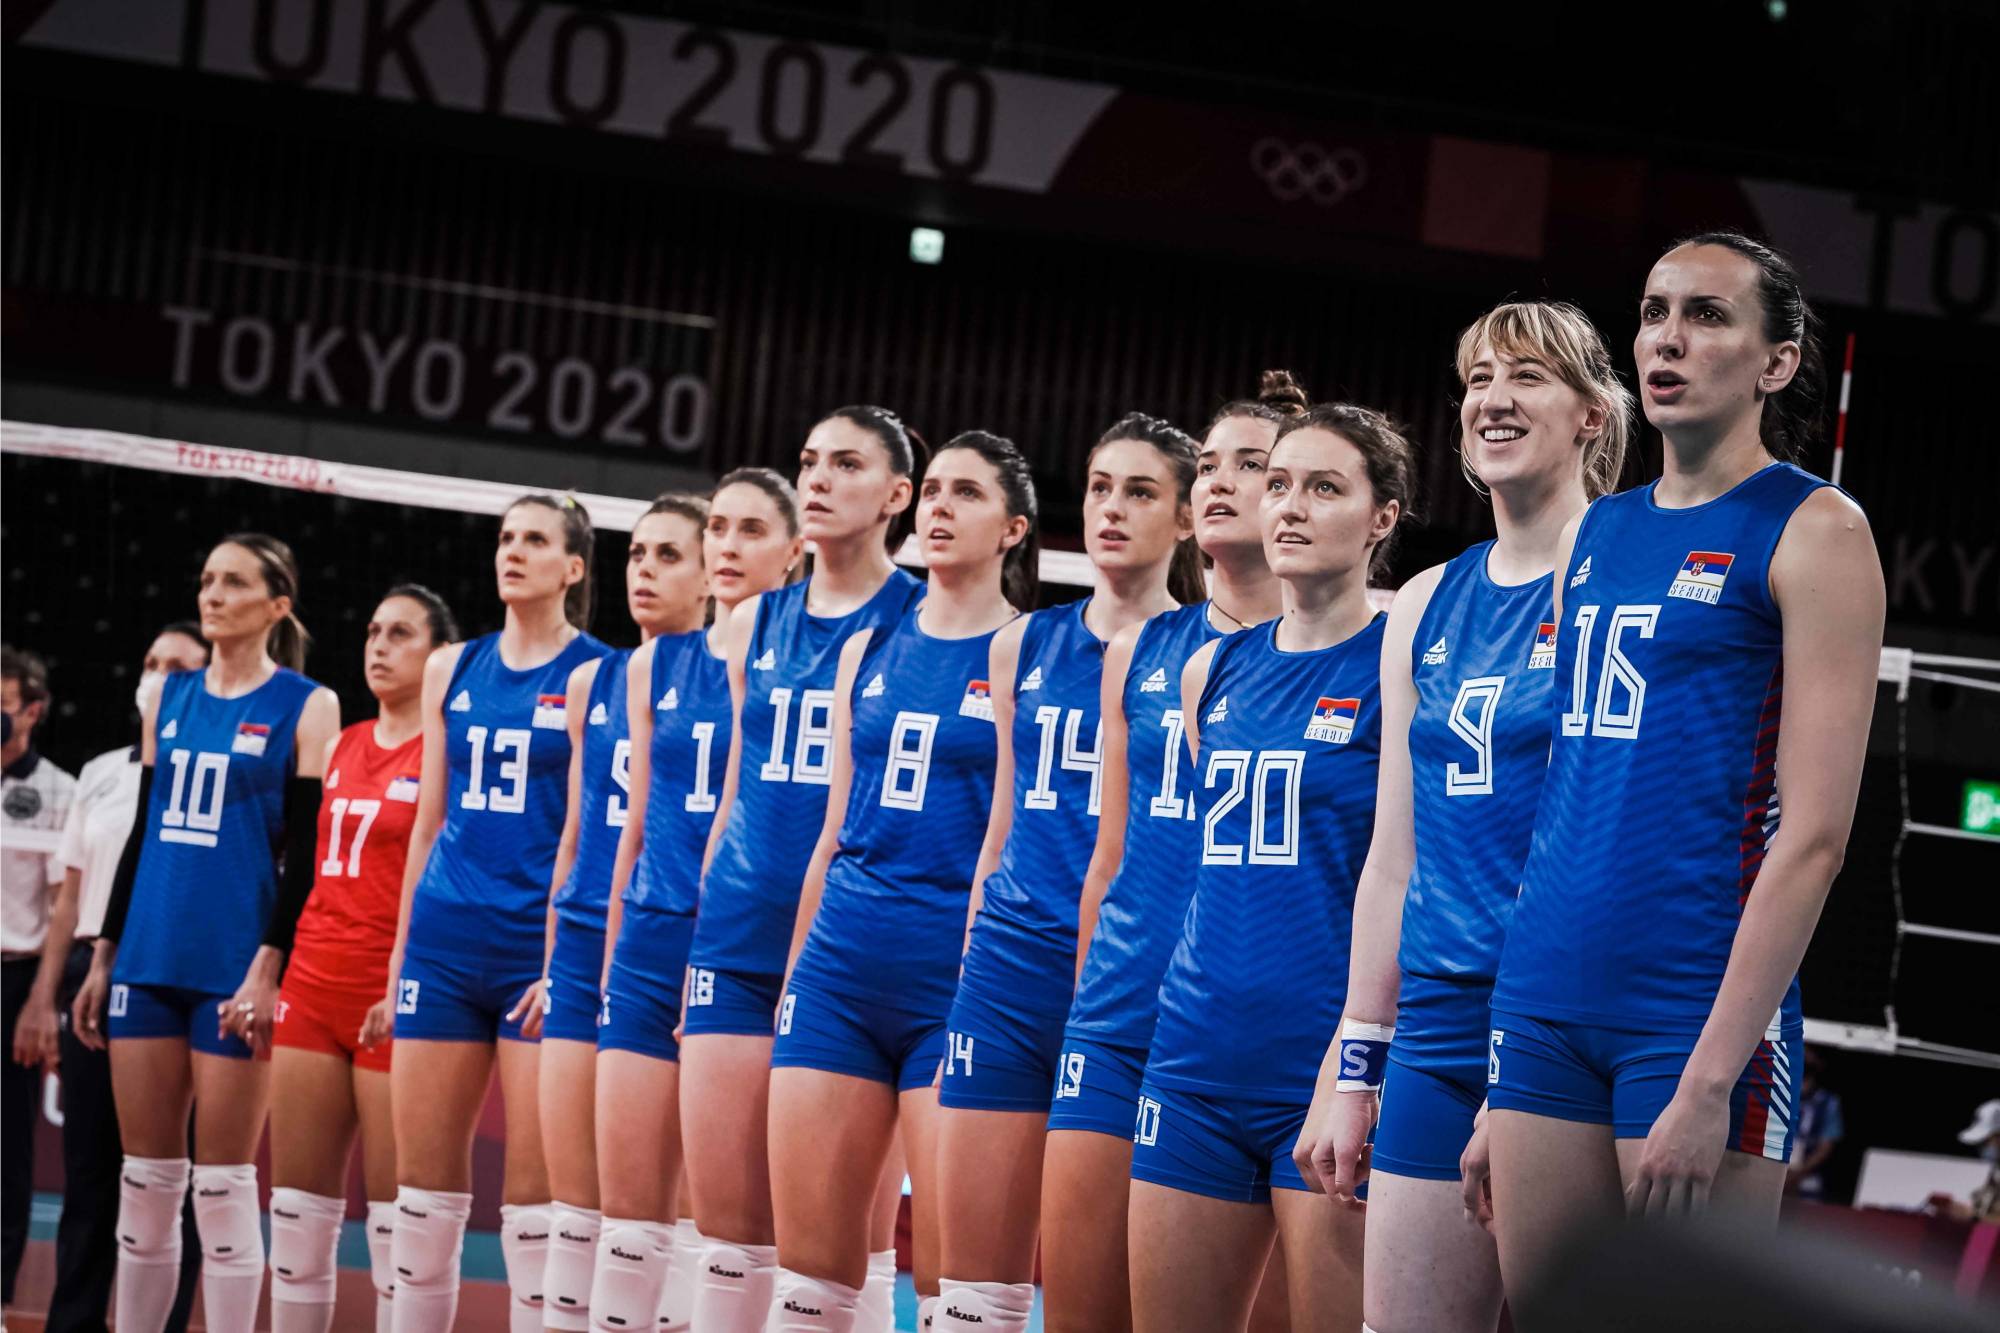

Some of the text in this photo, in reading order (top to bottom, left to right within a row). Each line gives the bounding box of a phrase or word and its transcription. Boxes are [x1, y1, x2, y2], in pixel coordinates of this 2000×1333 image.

[664, 28, 996, 182] 2020
[162, 305, 713, 452] TOKYO 2020
[176, 446, 255, 471] TOKYO
[1570, 571, 1592, 589] PEAK
[1669, 583, 1719, 603] SERBIA
[1422, 651, 1449, 665] PEAK
[1562, 605, 1662, 739] 16
[760, 688, 835, 785] 18
[1207, 710, 1229, 725] PEAK
[1305, 726, 1351, 744] SERBIA
[1446, 676, 1506, 796] 9
[162, 748, 230, 831] 10
[461, 726, 532, 814] 13
[685, 722, 716, 812] 1
[880, 711, 940, 811] 8
[1024, 705, 1104, 816] 14
[1150, 710, 1196, 821] 1
[321, 798, 381, 877] 17
[1202, 750, 1307, 866] 20
[688, 967, 715, 1007] 18
[945, 1032, 974, 1077] 14
[1056, 1052, 1085, 1099] 19
[1342, 1042, 1370, 1077] S
